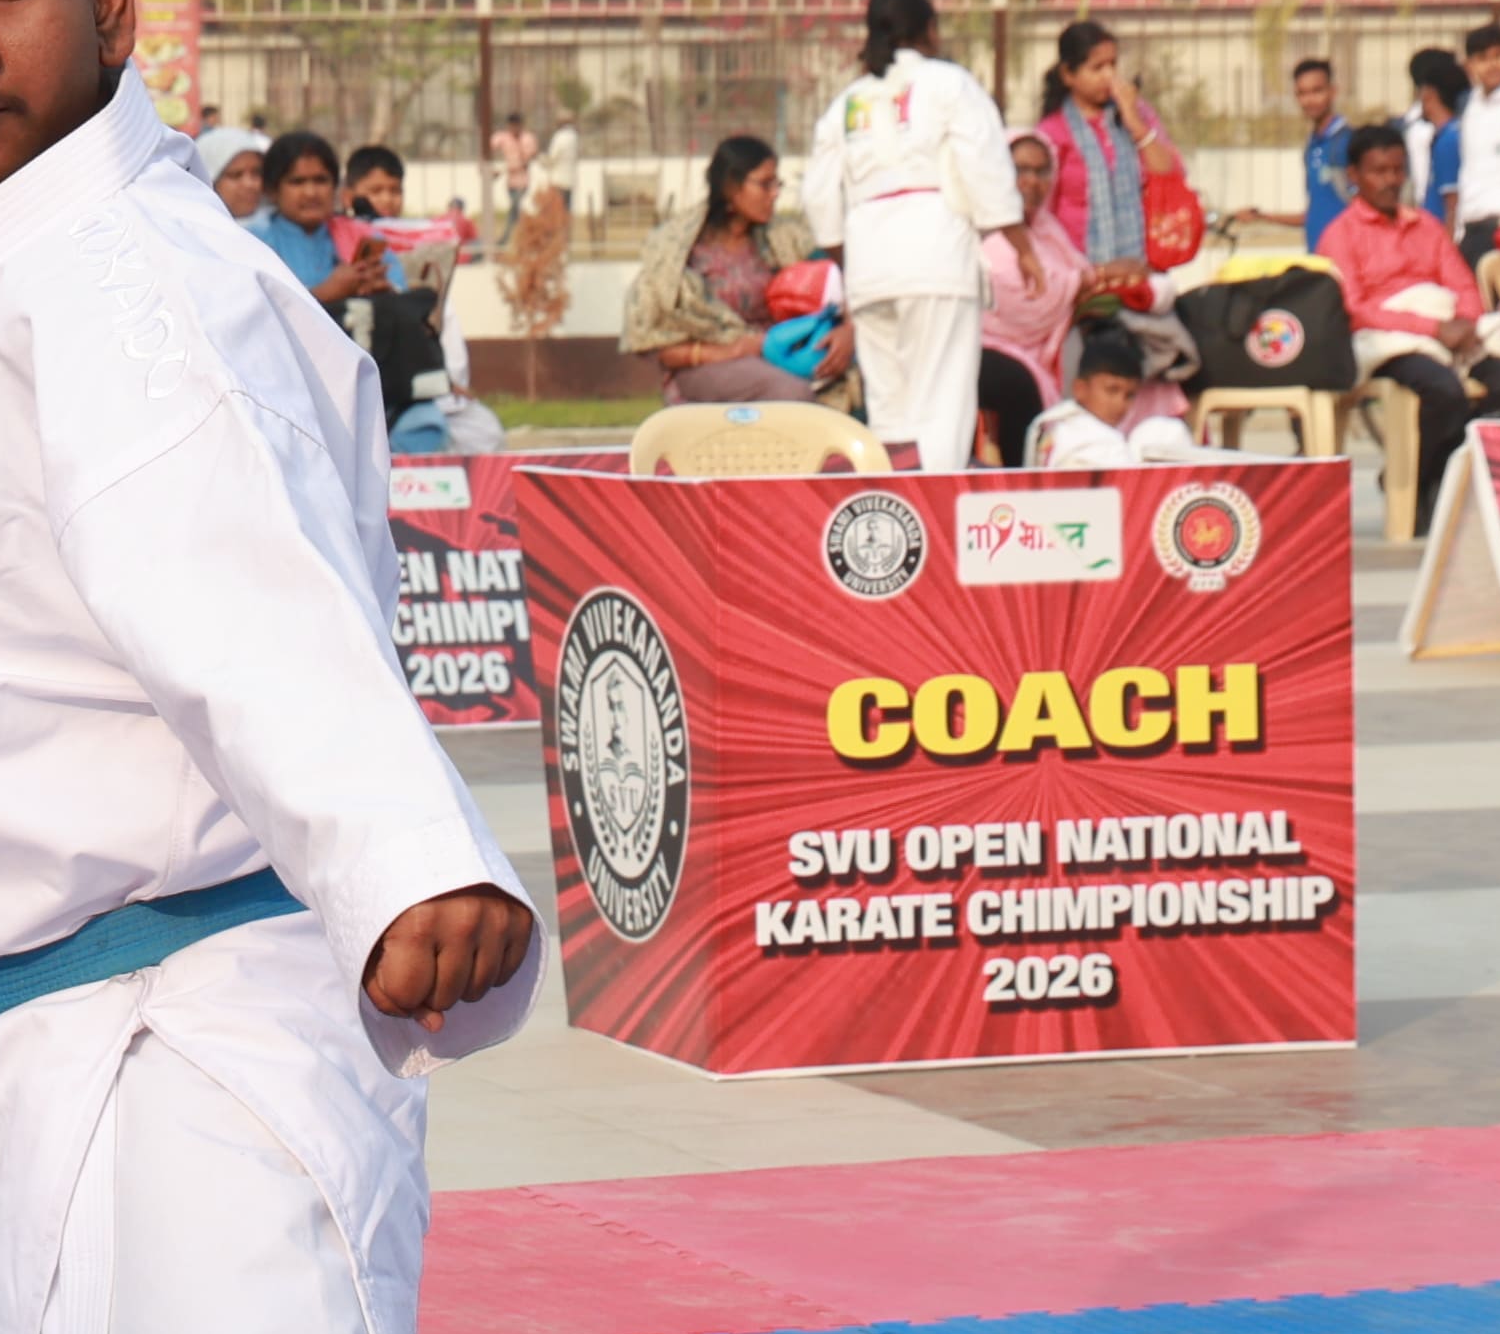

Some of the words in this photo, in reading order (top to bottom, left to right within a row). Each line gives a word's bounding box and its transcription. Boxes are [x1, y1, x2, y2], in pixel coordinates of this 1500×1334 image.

[1018, 520, 1090, 551] भात
[406, 650, 512, 695] 2026
[561, 631, 589, 772] SWAMI
[580, 597, 687, 787] VIVEKANANDA
[826, 662, 1259, 759] COACH
[608, 783, 661, 817] SVU
[787, 827, 891, 877] SVU
[904, 820, 1042, 872] OPEN
[1056, 809, 1302, 864] NATIONAL
[587, 843, 673, 932] UNIVERSITY
[754, 892, 954, 947] KARATE
[966, 875, 1335, 936] CHIMPIONSHIP
[982, 952, 1114, 1002] 2026
